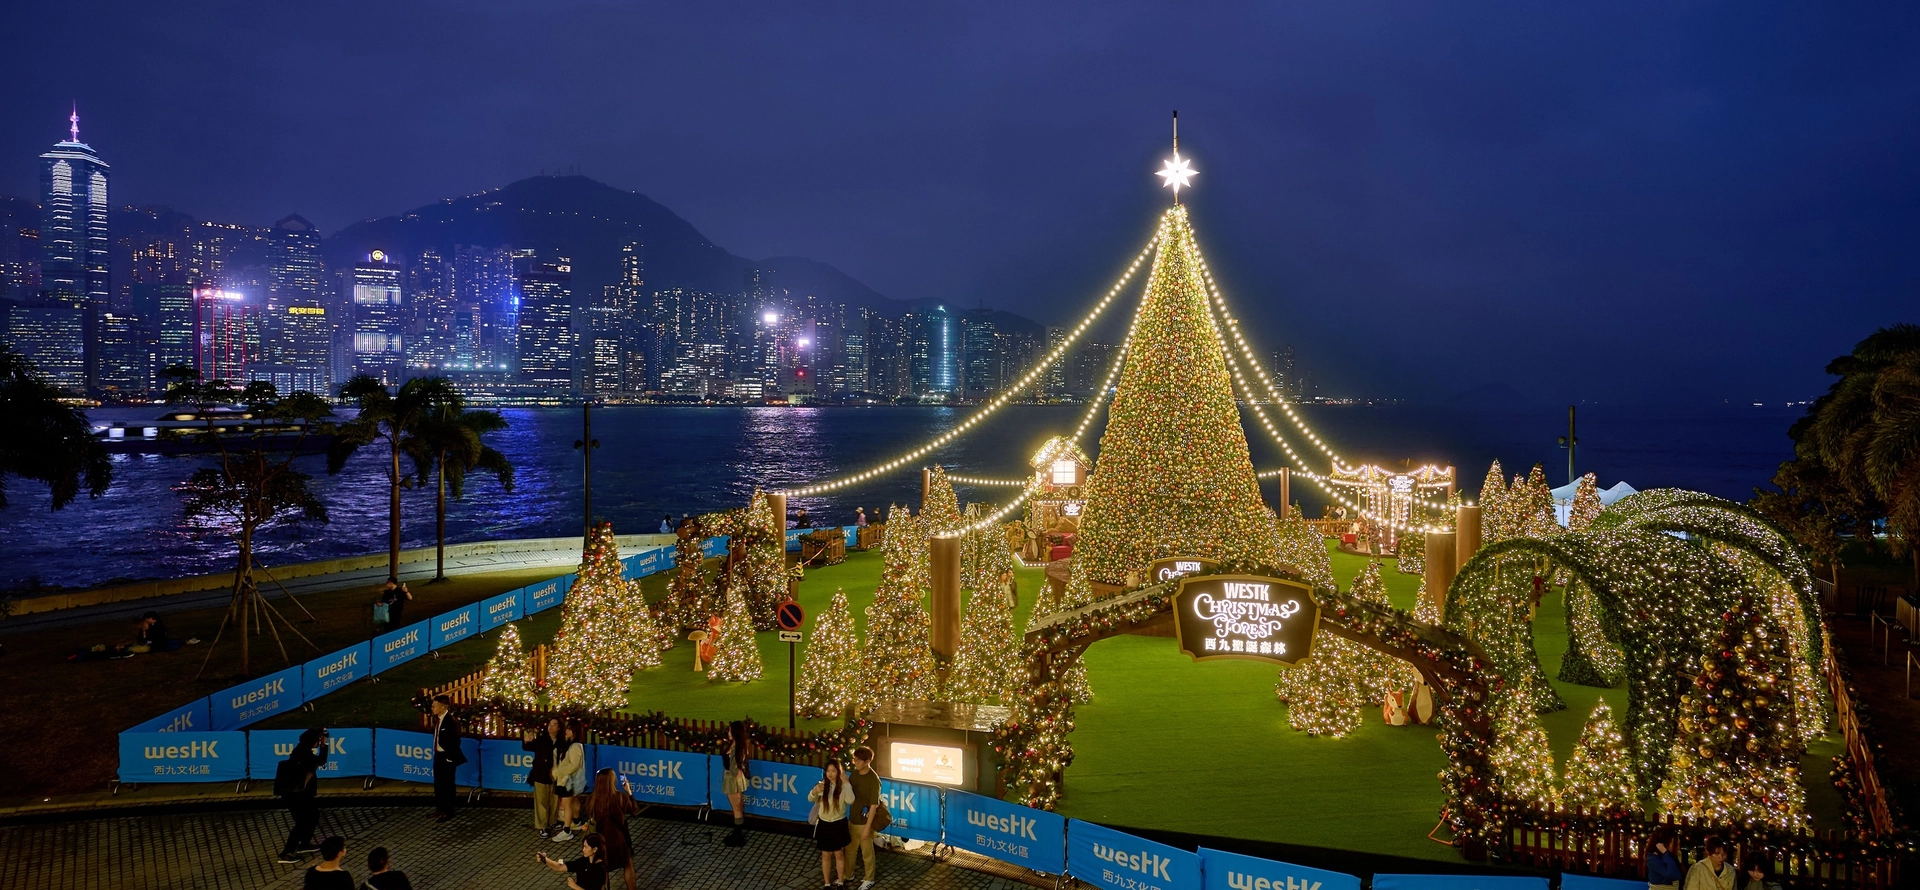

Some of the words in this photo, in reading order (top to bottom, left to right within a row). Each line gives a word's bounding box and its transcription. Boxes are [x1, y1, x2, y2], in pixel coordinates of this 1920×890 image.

[1176, 562, 1201, 571] WESTK
[534, 583, 556, 599] westK
[1224, 583, 1270, 601] WESTK
[489, 595, 516, 614] westK
[441, 611, 470, 632] westK
[384, 629, 418, 653] westK
[1205, 638, 1286, 654] 西九聖誕森林
[318, 651, 358, 678] westK
[324, 671, 354, 689] 西九文化區
[232, 678, 285, 709] westK
[239, 700, 279, 721] 西九文化區
[145, 741, 219, 759] westK
[395, 744, 432, 760] wes
[154, 765, 210, 775] 西九文化區
[618, 760, 683, 780] westK
[751, 772, 798, 794] estK
[968, 809, 1037, 841] westK
[976, 834, 1029, 858] 西九文化區
[1094, 842, 1172, 882] westK
